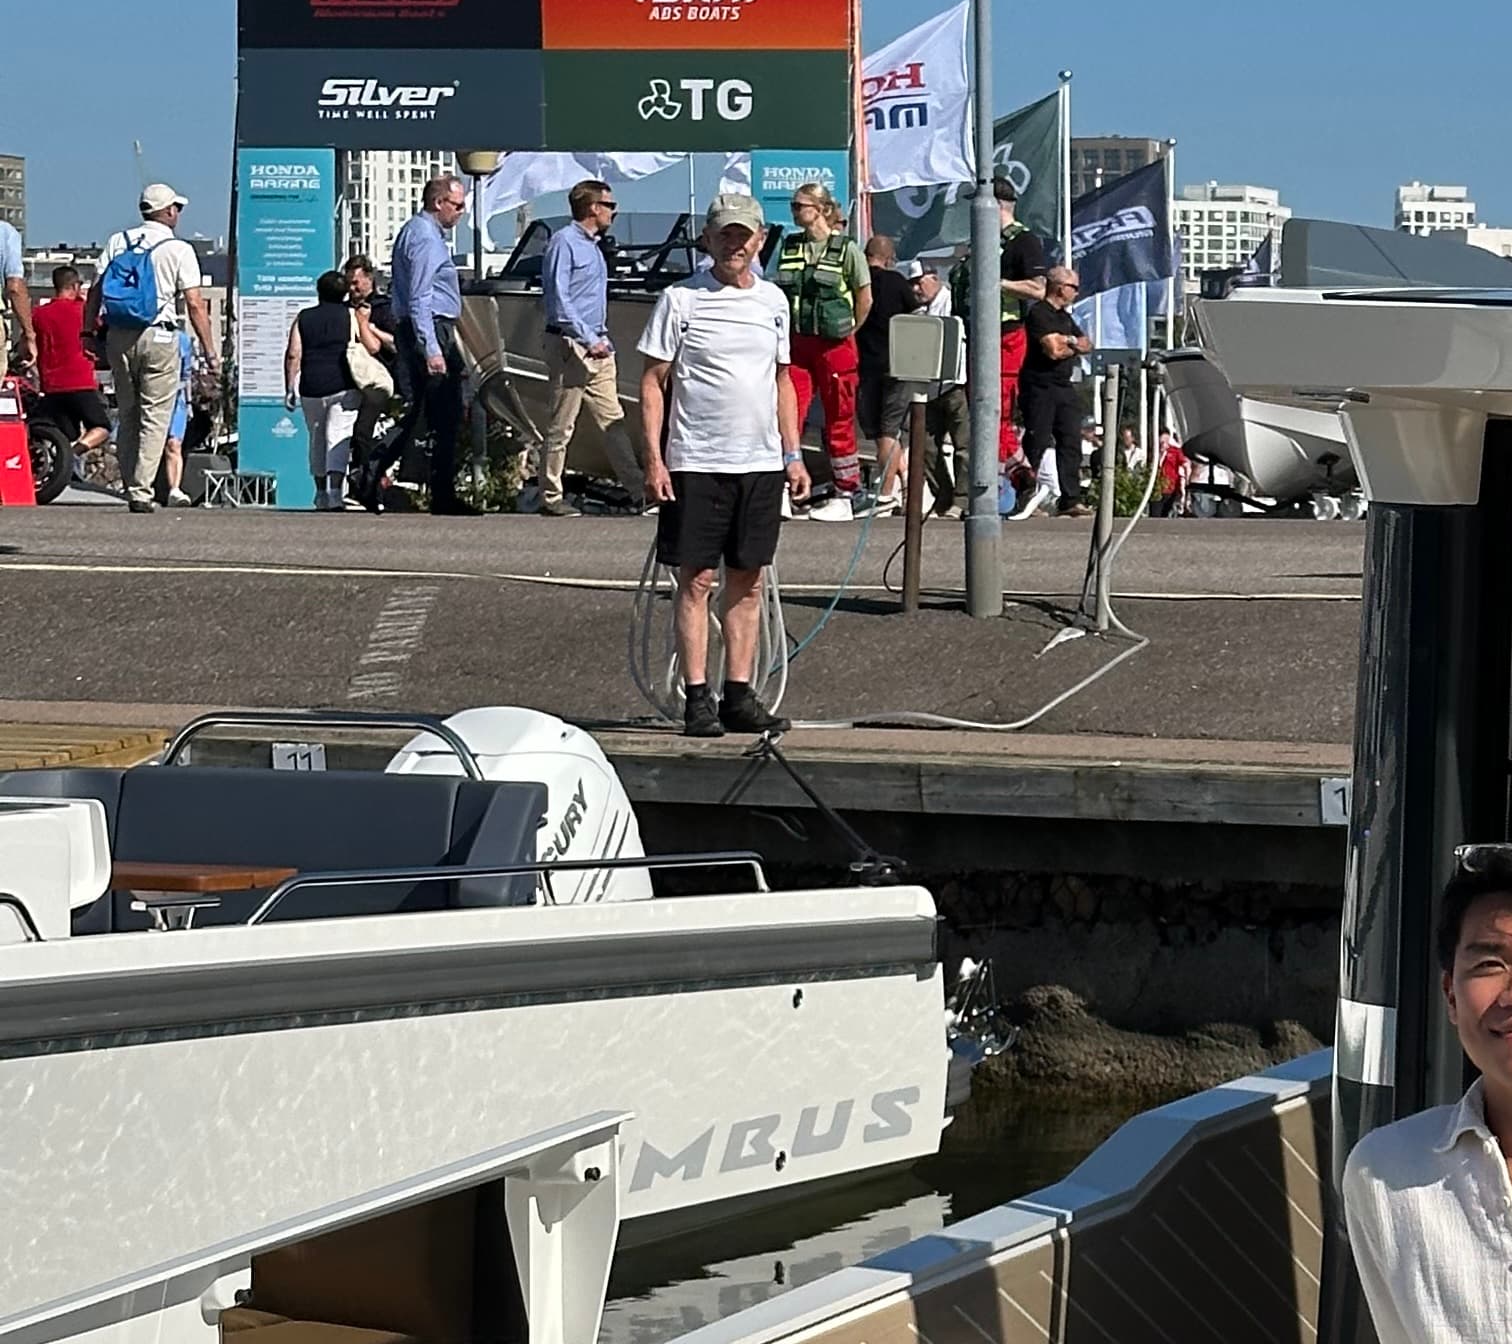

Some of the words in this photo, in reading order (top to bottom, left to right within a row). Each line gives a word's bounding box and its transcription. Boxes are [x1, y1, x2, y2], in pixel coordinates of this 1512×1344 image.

[648, 6, 682, 20] ABS
[687, 6, 741, 20] BOATS
[318, 79, 455, 106] Silver
[680, 79, 752, 121] TG
[318, 110, 349, 119] TIME
[356, 110, 388, 119] WELL
[395, 110, 436, 119] SPENT
[250, 164, 320, 176] HONDA
[763, 166, 834, 177] HONDA
[286, 751, 312, 771] 11
